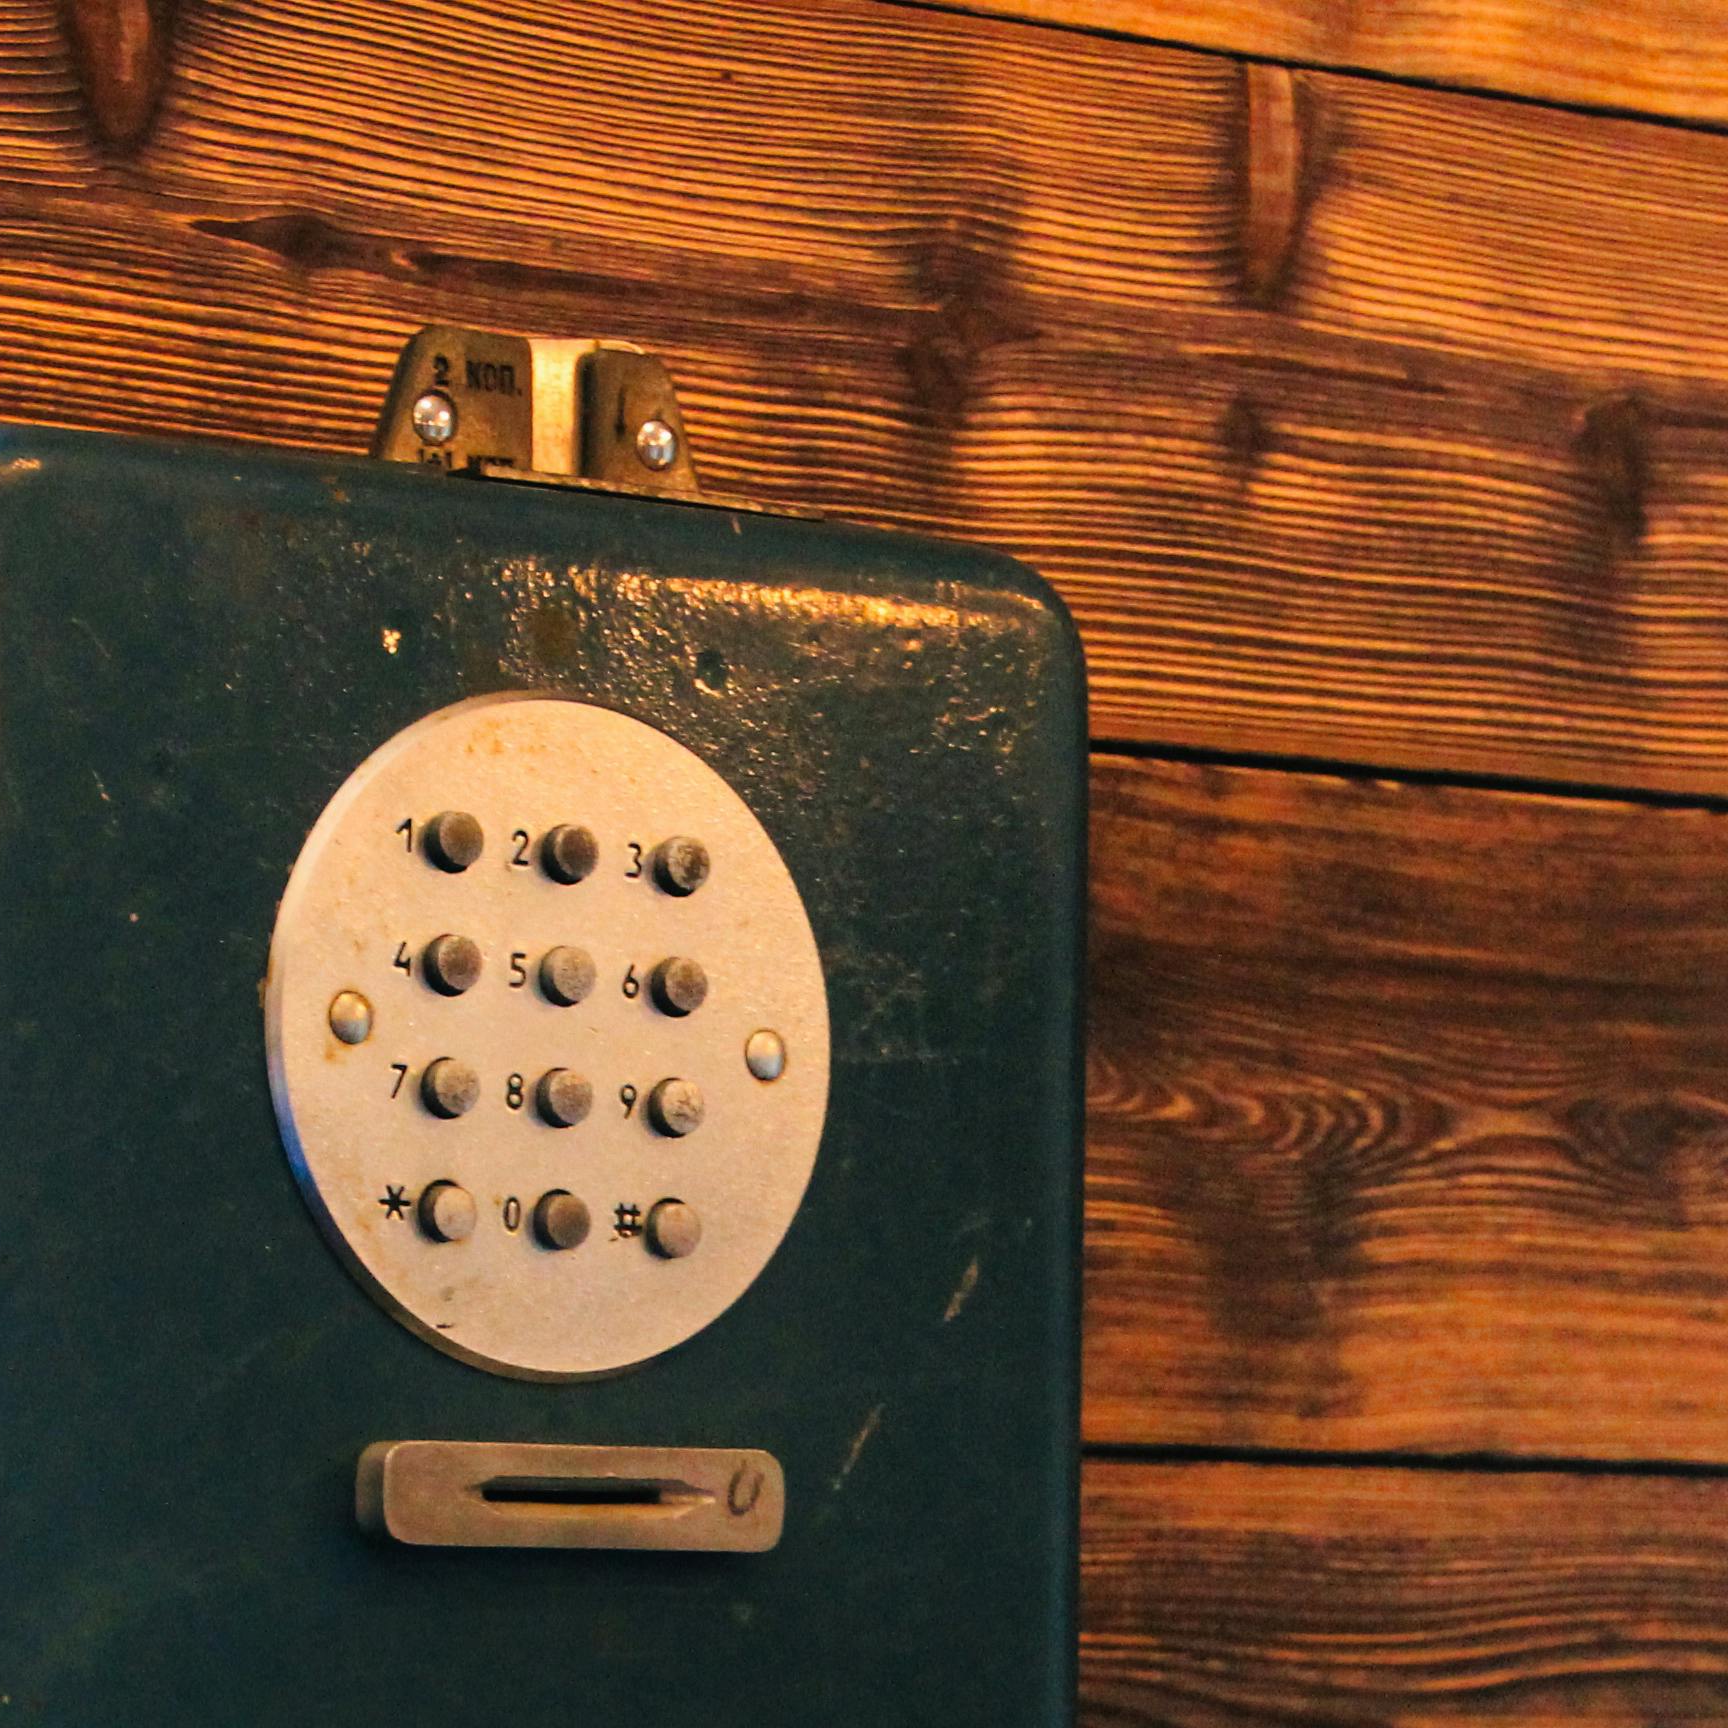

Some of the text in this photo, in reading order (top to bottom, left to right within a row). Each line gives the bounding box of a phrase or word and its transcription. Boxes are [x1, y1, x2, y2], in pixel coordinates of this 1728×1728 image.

[395, 818, 644, 879] 1 2 3
[393, 941, 640, 999] 4 5 6
[389, 1063, 637, 1120] 7 8 9
[503, 1196, 521, 1232] 0
[614, 1202, 642, 1239] #
